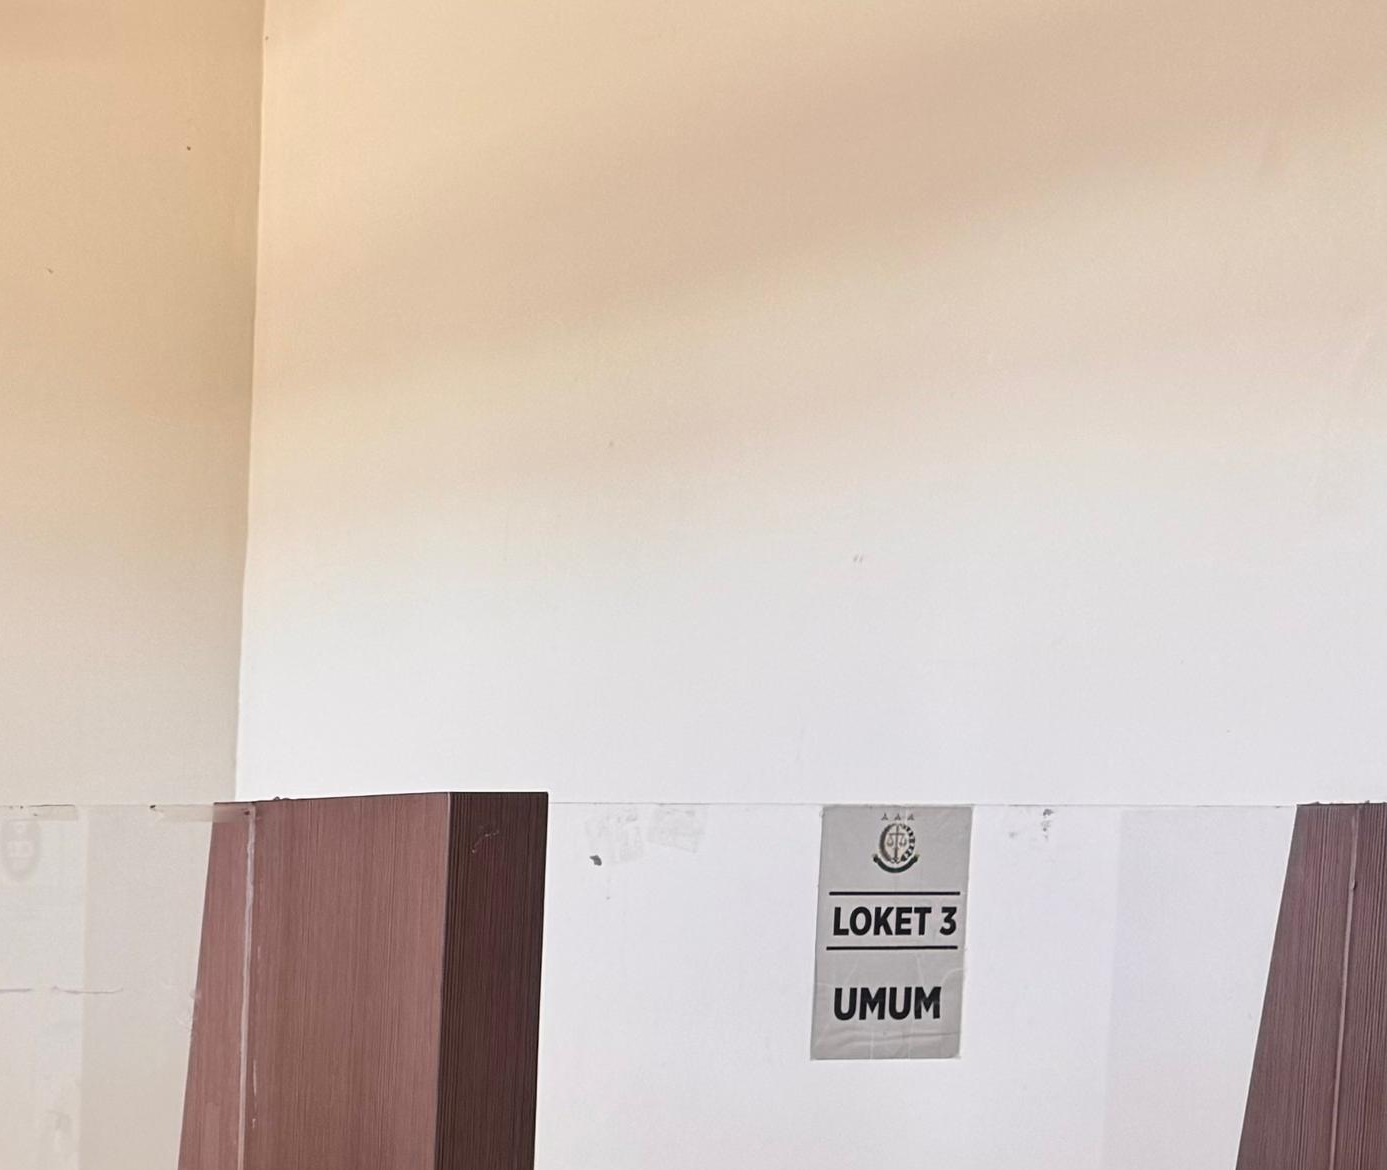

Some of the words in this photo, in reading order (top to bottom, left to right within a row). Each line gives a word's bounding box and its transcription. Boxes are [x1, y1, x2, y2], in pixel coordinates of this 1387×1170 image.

[833, 906, 932, 936] LOKET
[939, 906, 957, 936] 3
[834, 986, 942, 1021] UMUM
